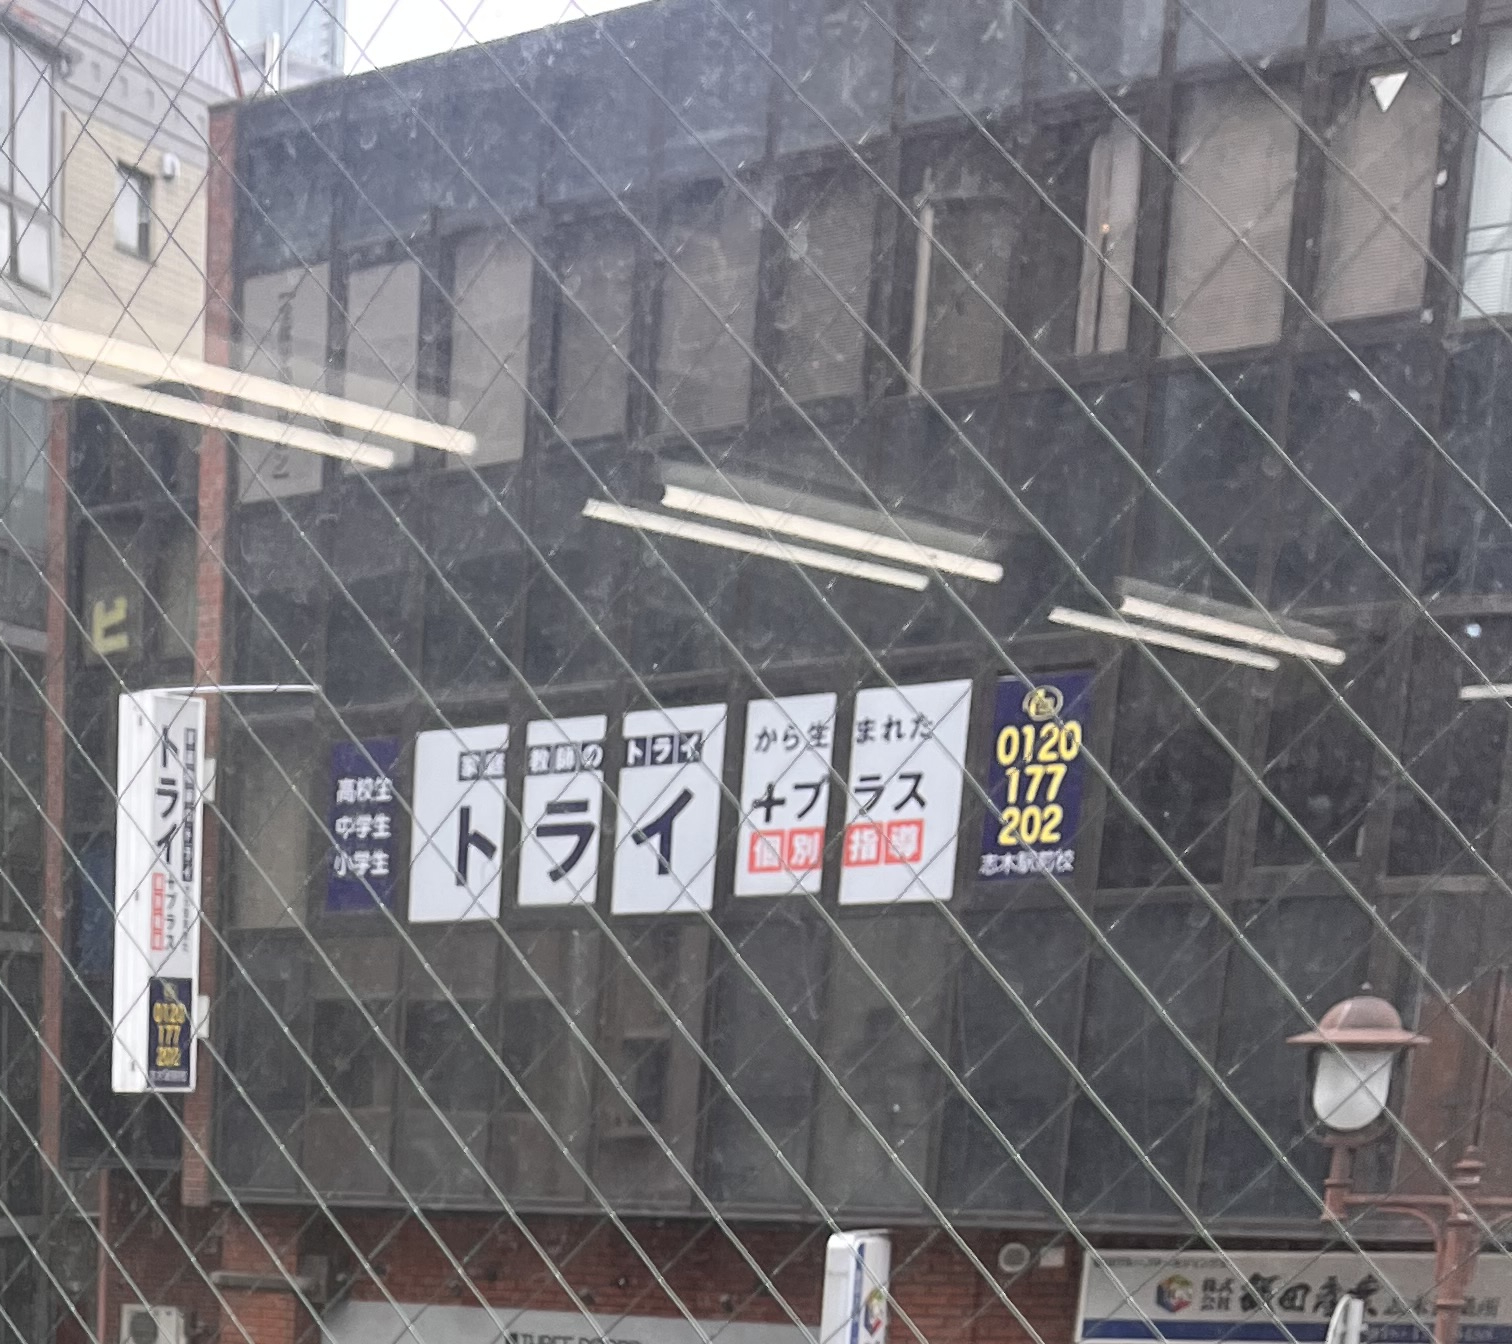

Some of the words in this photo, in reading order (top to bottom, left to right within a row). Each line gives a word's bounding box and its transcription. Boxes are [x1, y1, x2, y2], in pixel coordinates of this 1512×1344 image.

[754, 713, 934, 752] から生まれた
[996, 719, 1082, 767] 0120
[155, 724, 178, 864] トライ
[336, 776, 393, 804] 高校生
[1005, 763, 1068, 804] 177
[335, 812, 391, 839] 中学生
[456, 788, 694, 887] トライ
[998, 803, 1063, 846] 202
[334, 850, 390, 877] 小学生
[749, 819, 924, 873] 個別指導
